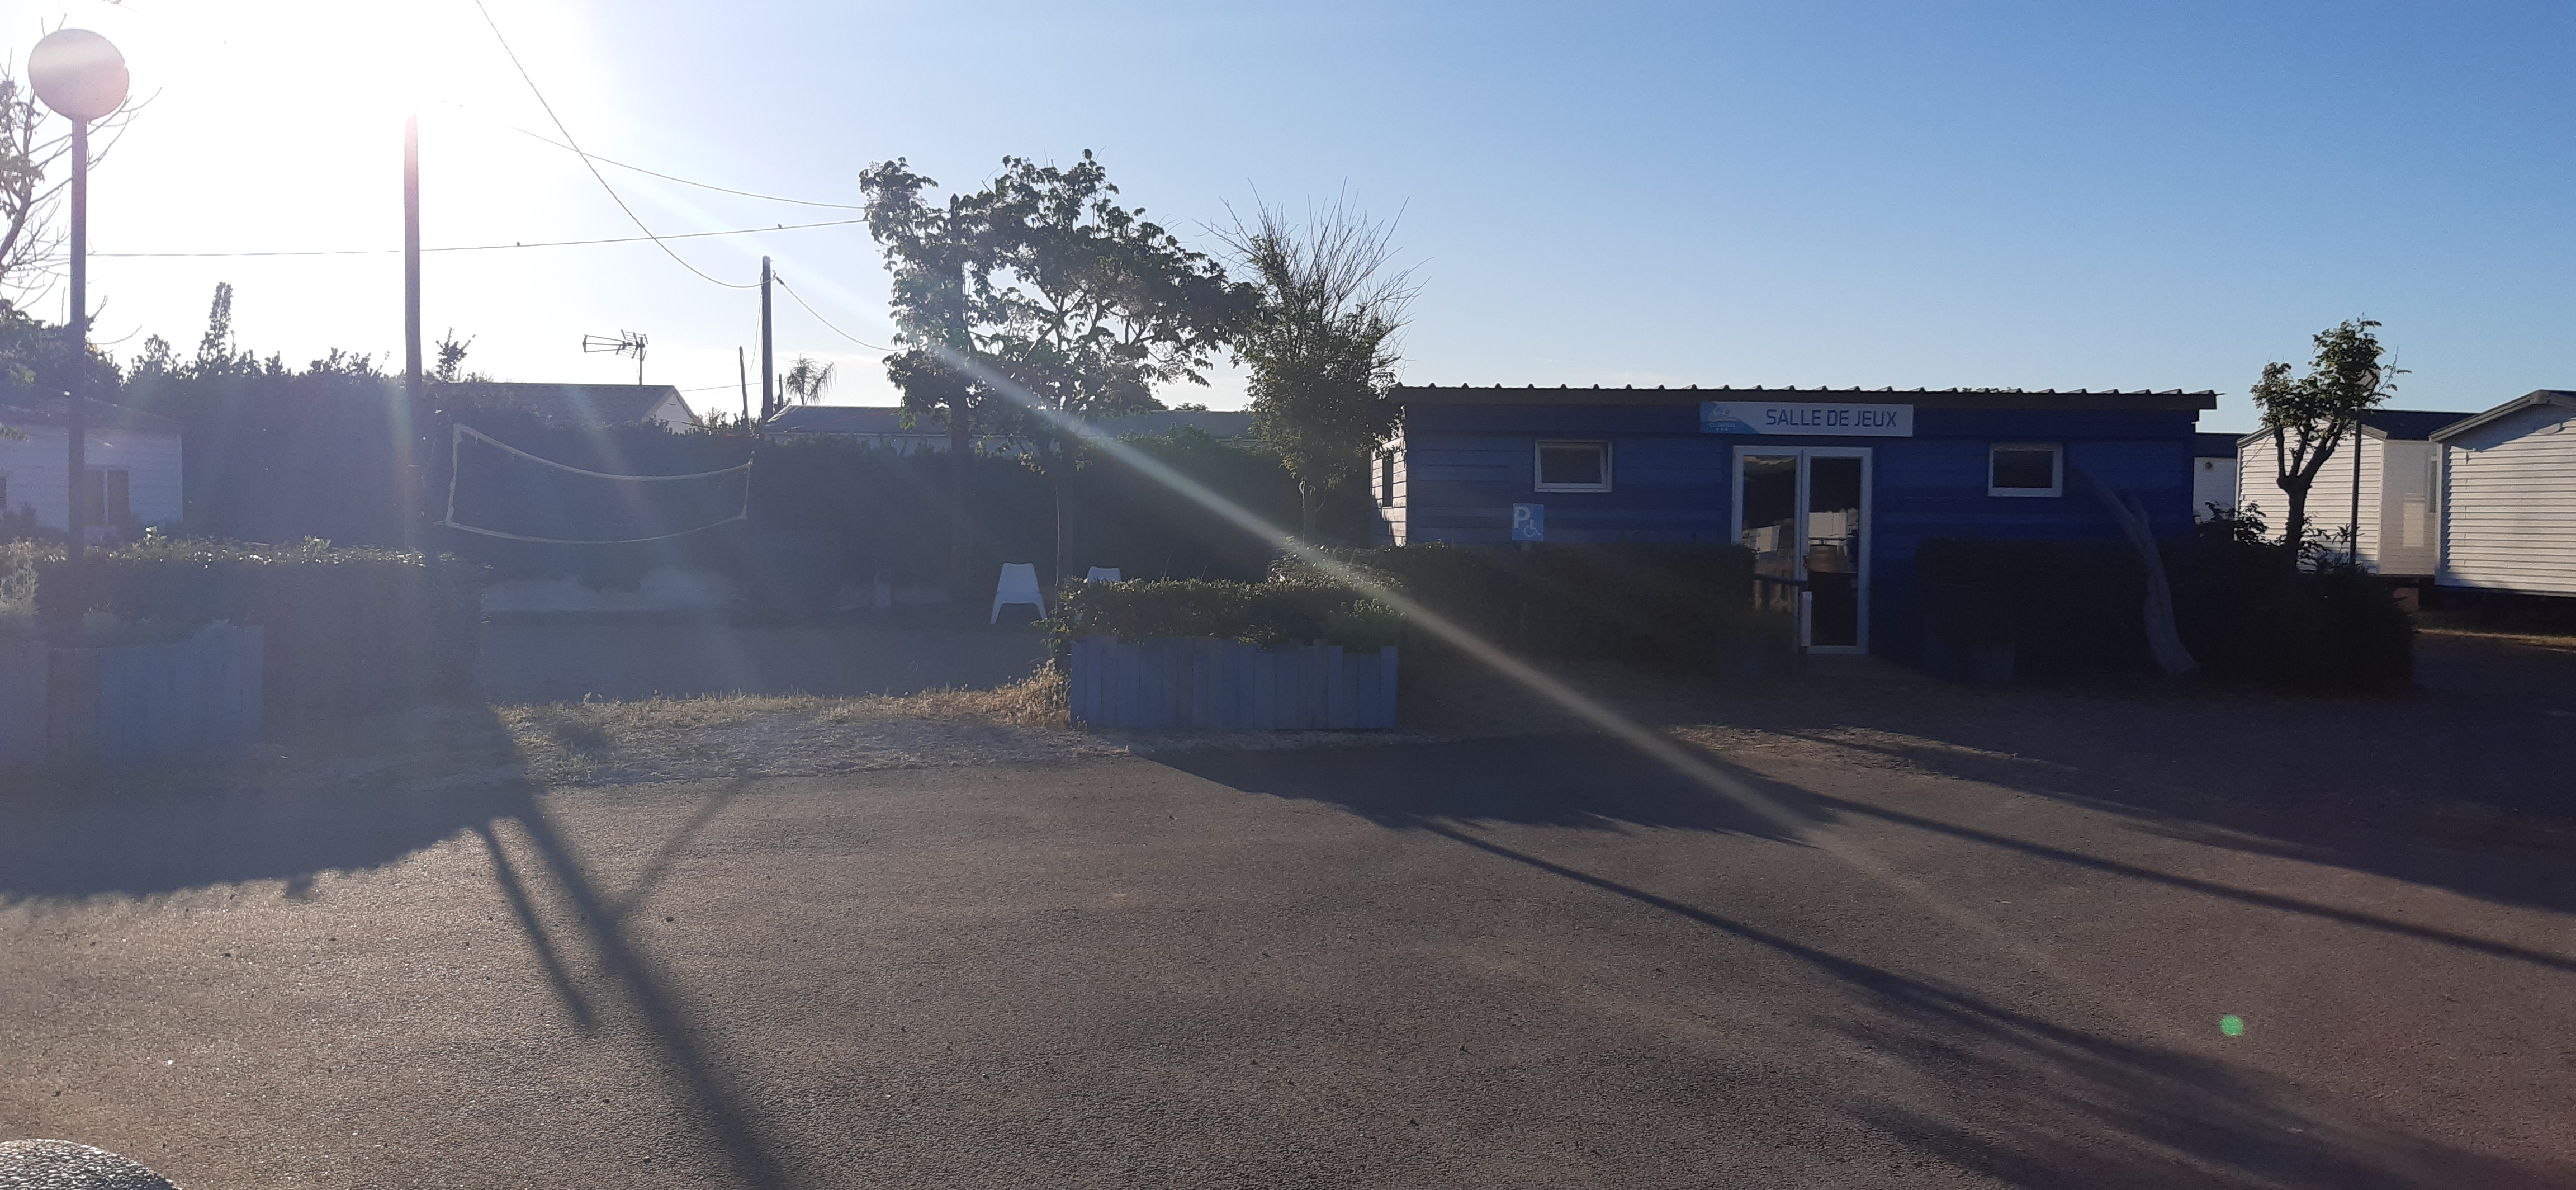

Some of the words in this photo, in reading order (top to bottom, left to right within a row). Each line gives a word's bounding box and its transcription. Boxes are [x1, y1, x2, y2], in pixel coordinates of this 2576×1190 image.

[1765, 409, 1821, 426] SALLE
[1827, 410, 1849, 427] DE
[1854, 410, 1897, 428] JEUX
[1514, 506, 1531, 528] P
